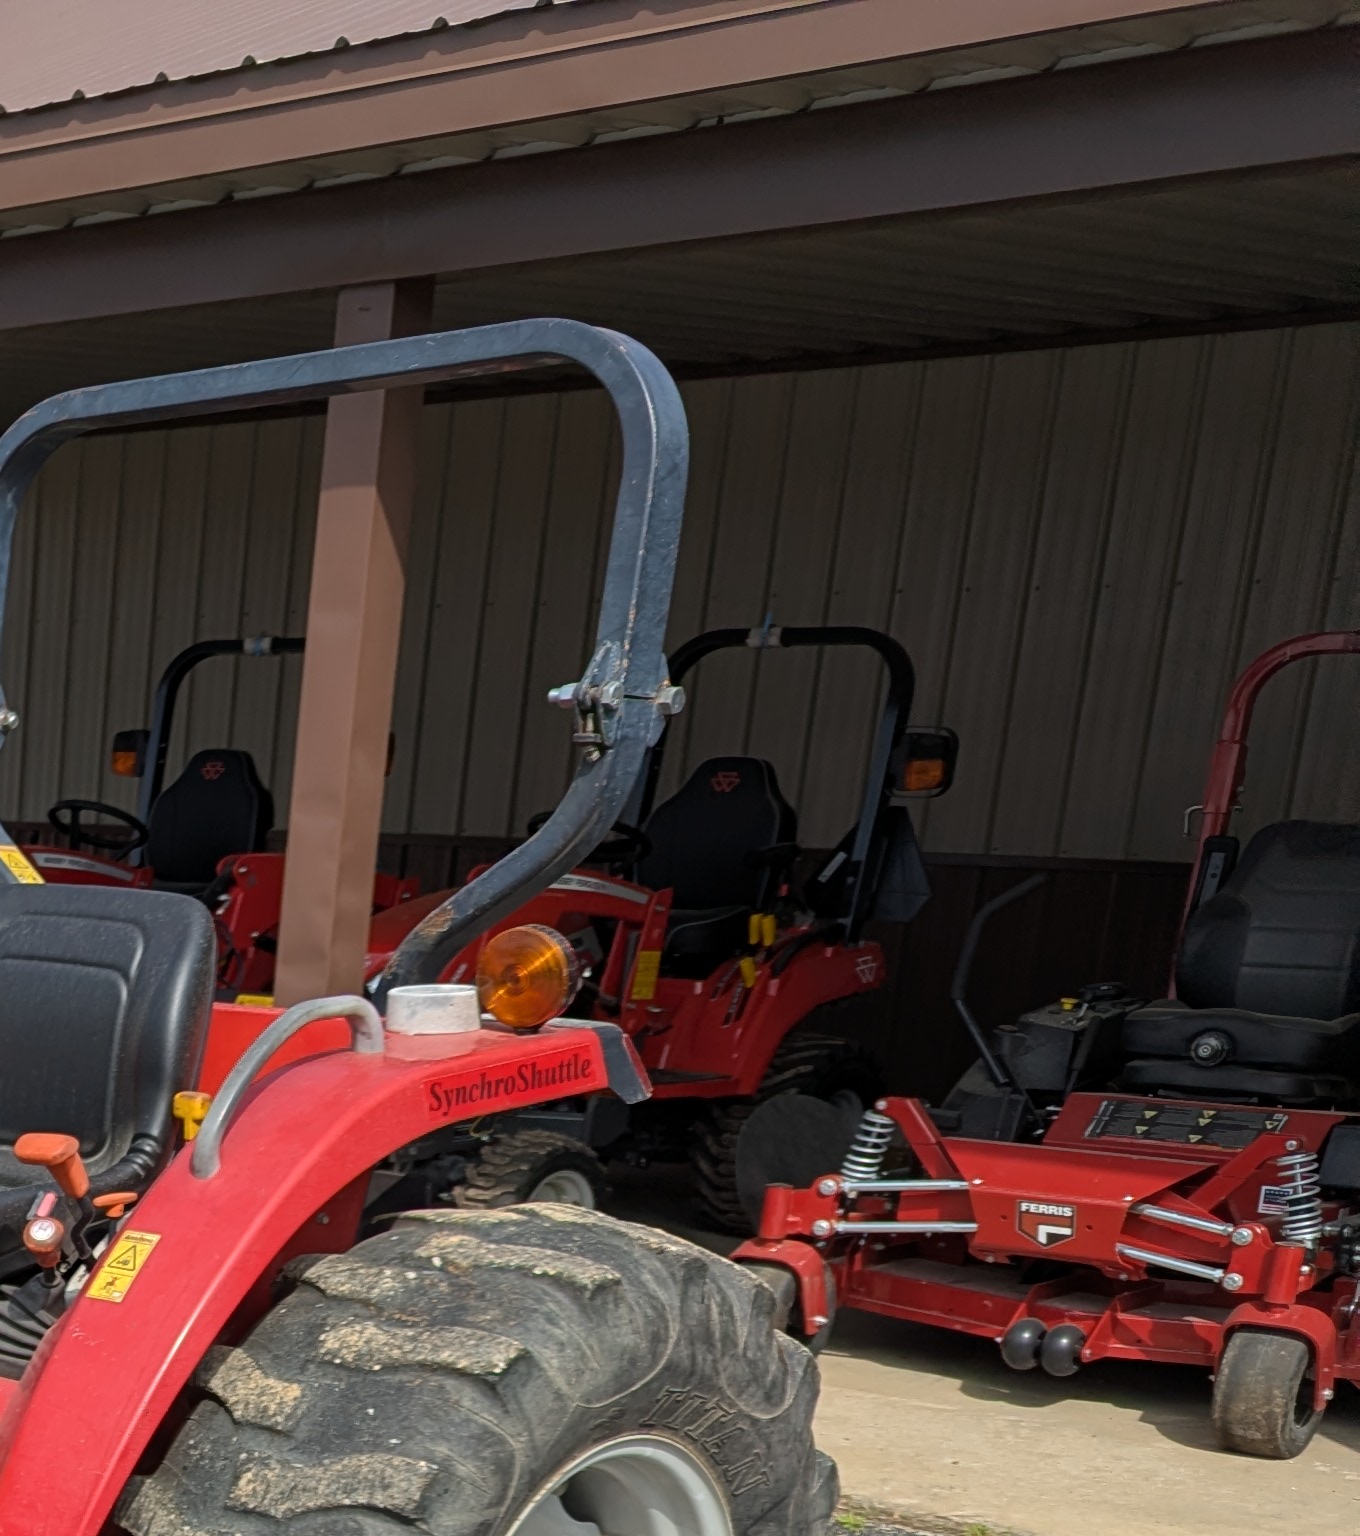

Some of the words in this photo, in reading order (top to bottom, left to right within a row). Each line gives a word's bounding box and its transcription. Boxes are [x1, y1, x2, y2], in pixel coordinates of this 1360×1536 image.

[428, 1052, 592, 1116] SynchroShuttle
[1020, 1202, 1073, 1217] FERRIS
[638, 1385, 771, 1497] TITAN
